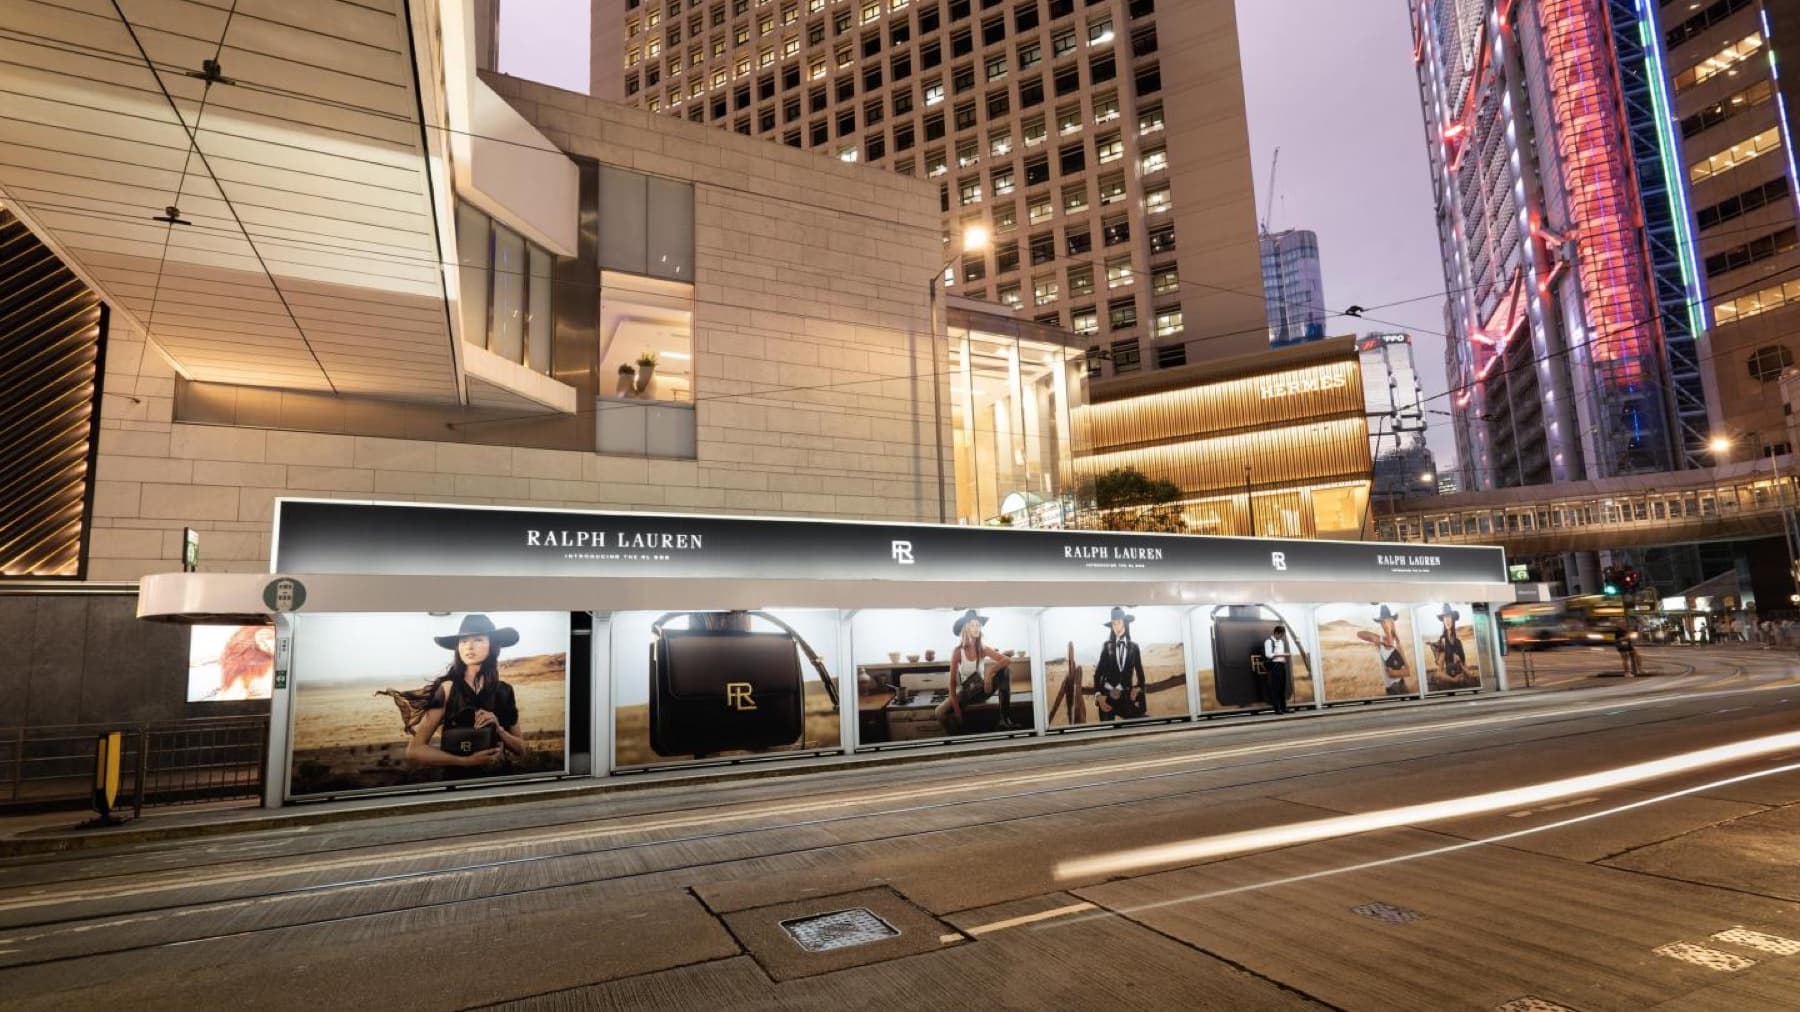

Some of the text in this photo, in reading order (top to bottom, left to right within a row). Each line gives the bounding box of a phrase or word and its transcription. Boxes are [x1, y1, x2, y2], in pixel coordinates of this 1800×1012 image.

[527, 530, 703, 549] RALPH LAUREN
[1064, 545, 1163, 560] RALPH LAUREN
[1377, 555, 1441, 566] RALPH LAUREN
